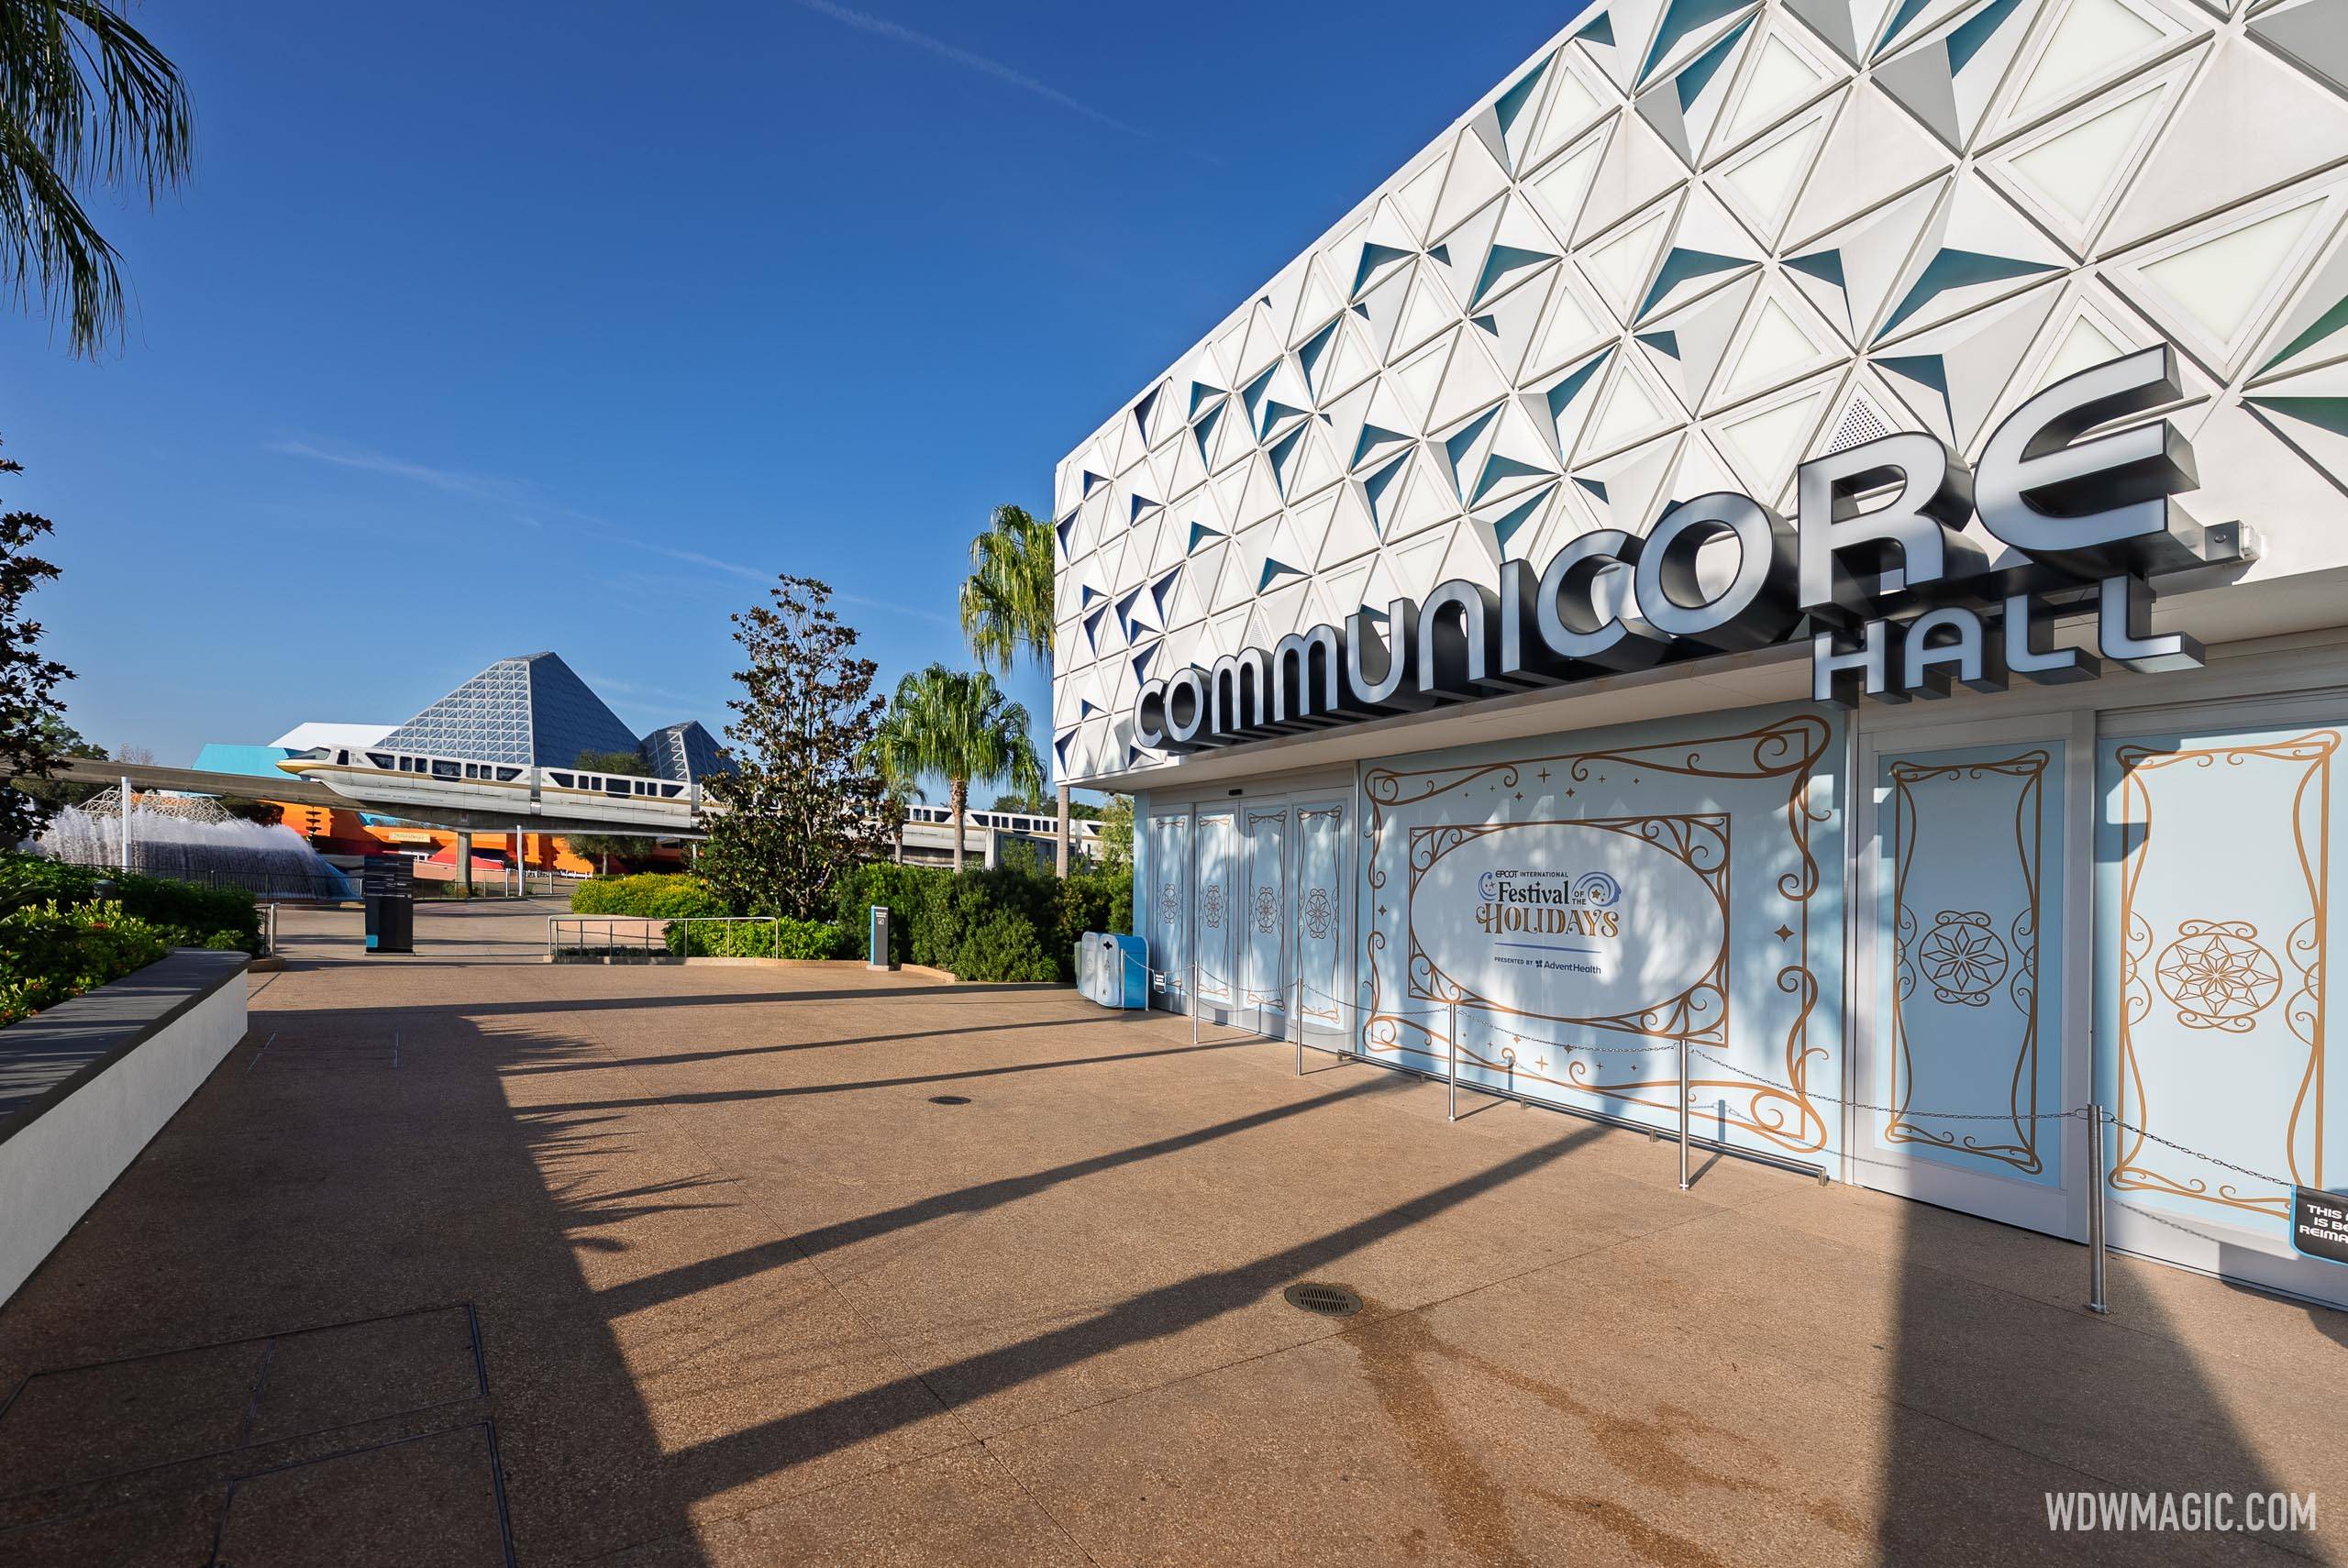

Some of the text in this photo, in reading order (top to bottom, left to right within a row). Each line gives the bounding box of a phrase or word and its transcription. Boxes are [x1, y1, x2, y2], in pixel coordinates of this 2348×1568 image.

[1812, 572, 2187, 702] HALL
[1498, 880, 1569, 904] Festival
[1476, 902, 1620, 938] HOLIDAYS
[1494, 956, 1524, 965] PRESENTED
[1544, 961, 1601, 975] AdventHealth
[2307, 1204, 2342, 1220] THIS
[2314, 1217, 2329, 1228] IS
